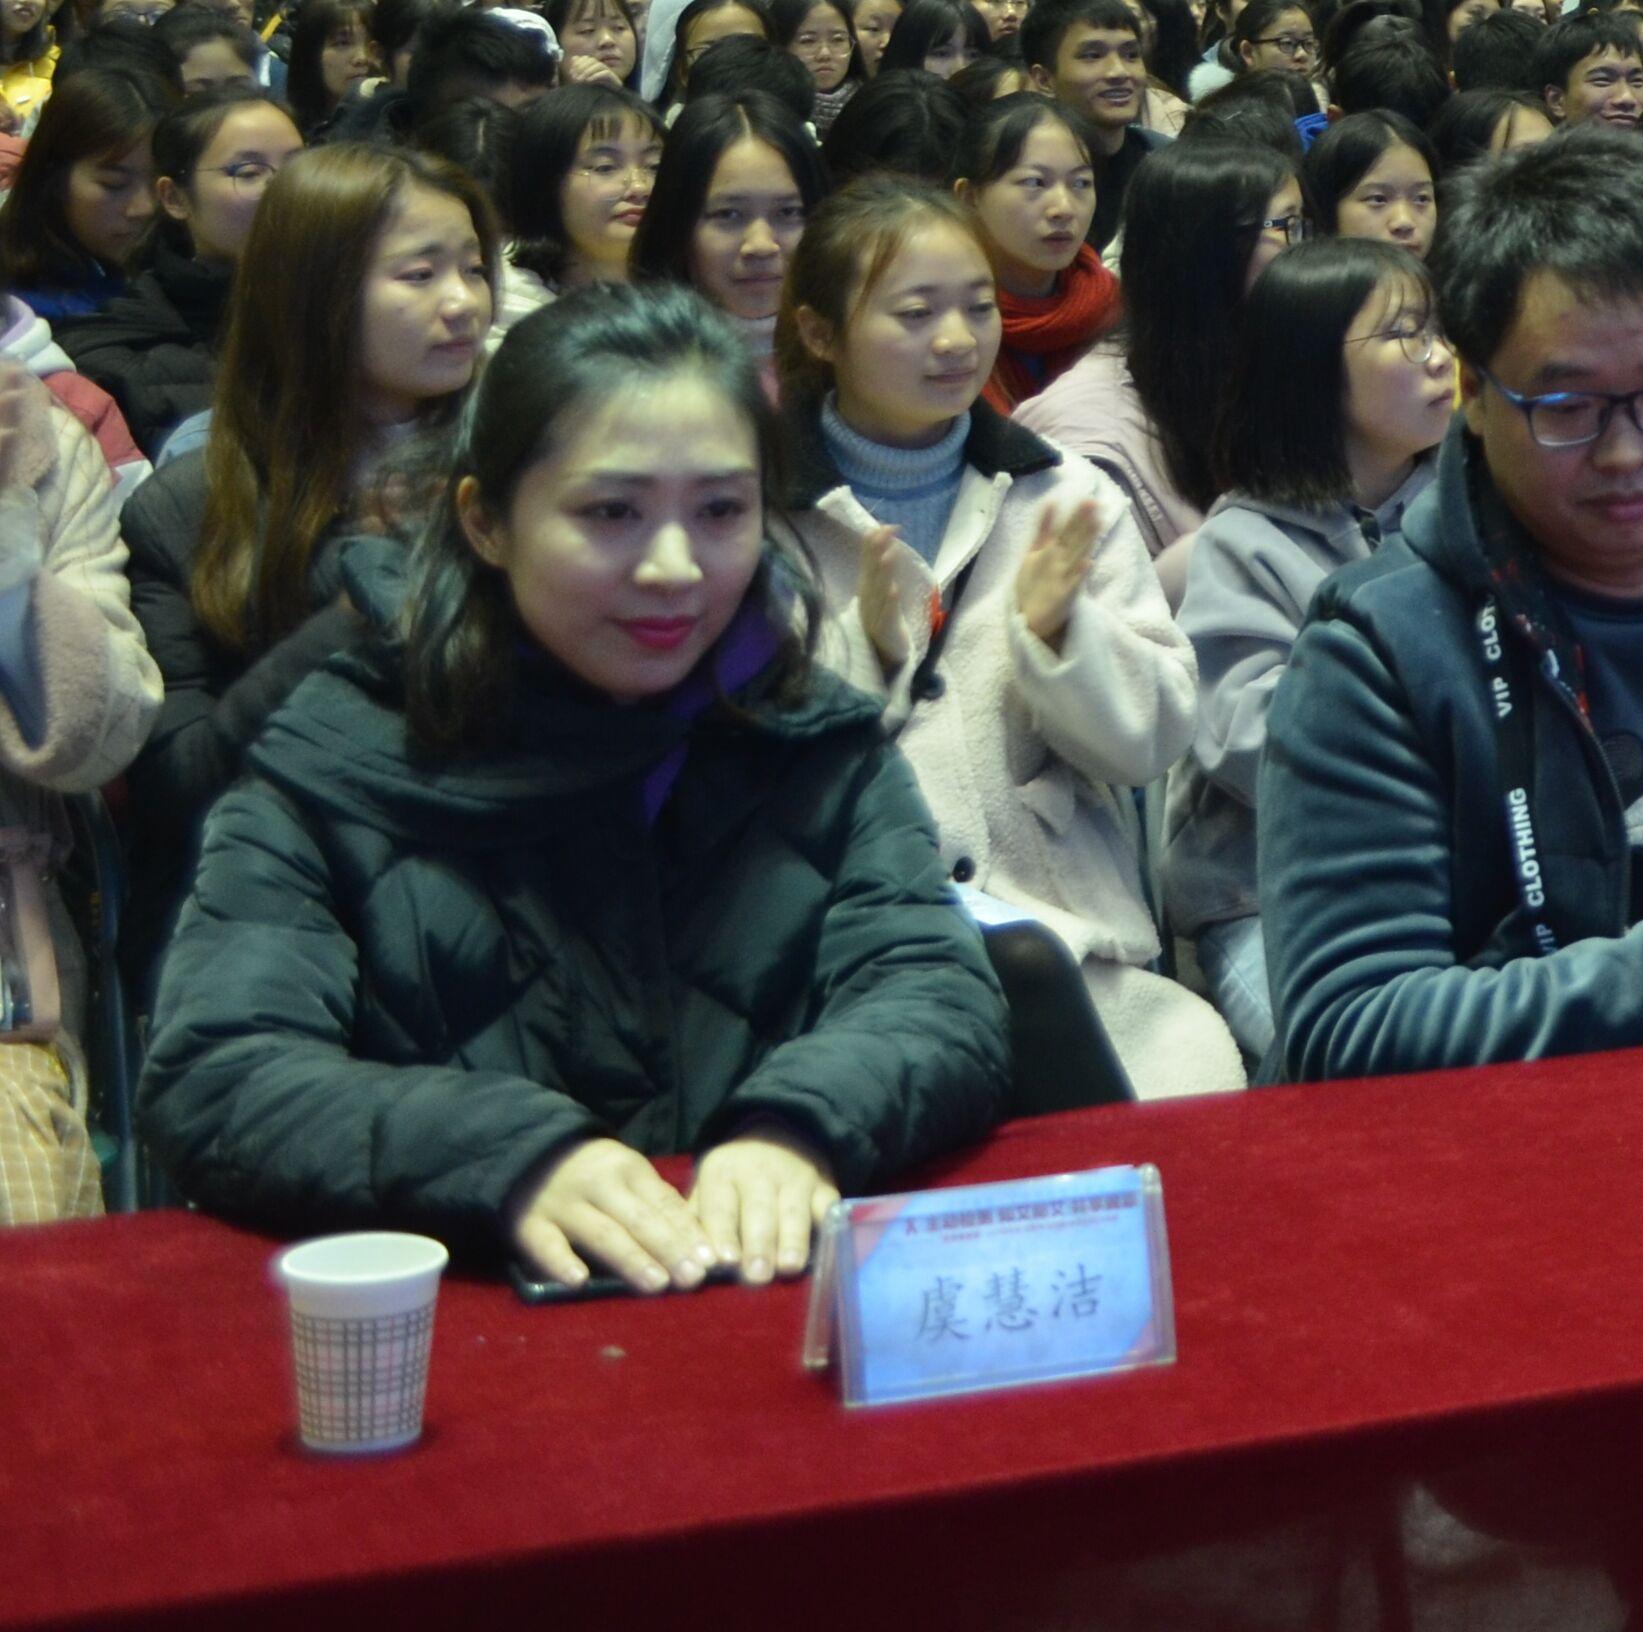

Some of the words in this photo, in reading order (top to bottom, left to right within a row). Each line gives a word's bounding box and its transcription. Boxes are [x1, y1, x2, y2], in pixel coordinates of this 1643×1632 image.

[1480, 597, 1502, 661] CLOT
[1492, 676, 1513, 718] VIP
[1509, 787, 1545, 908] CLOTHING
[914, 1261, 1104, 1342] 虞慧洁
